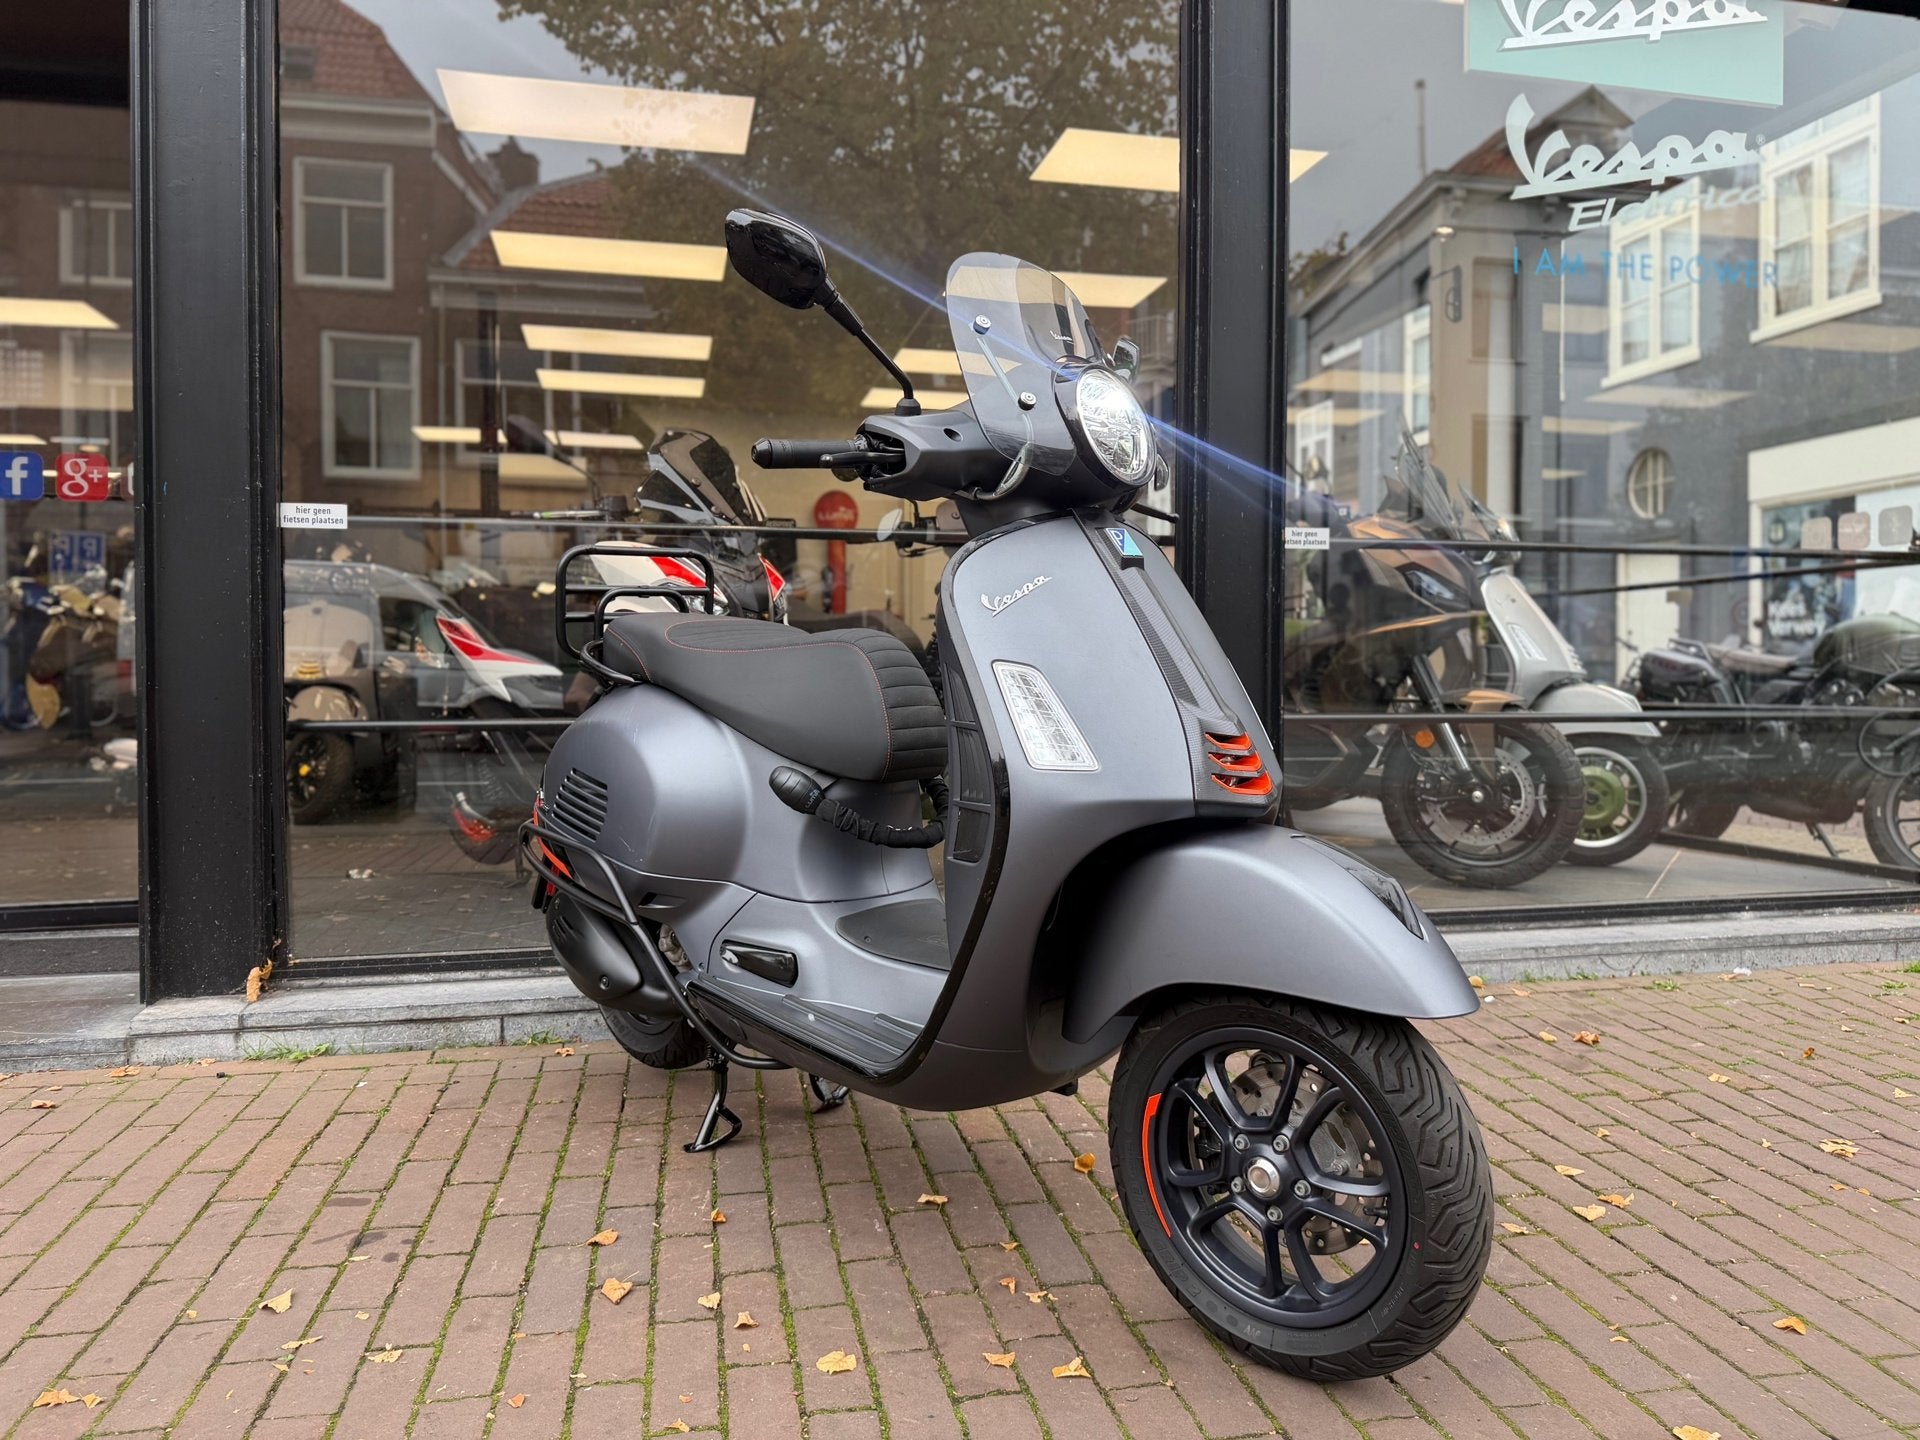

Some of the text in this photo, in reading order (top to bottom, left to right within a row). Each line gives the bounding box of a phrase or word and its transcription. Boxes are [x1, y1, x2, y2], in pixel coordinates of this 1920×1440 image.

[1513, 245, 1778, 288] I AM THE POWER
[295, 506, 331, 516] hier geen
[283, 515, 344, 525] fietsen plaatsen
[1303, 538, 1326, 546] plaatsen
[980, 575, 1053, 618] Vespa
